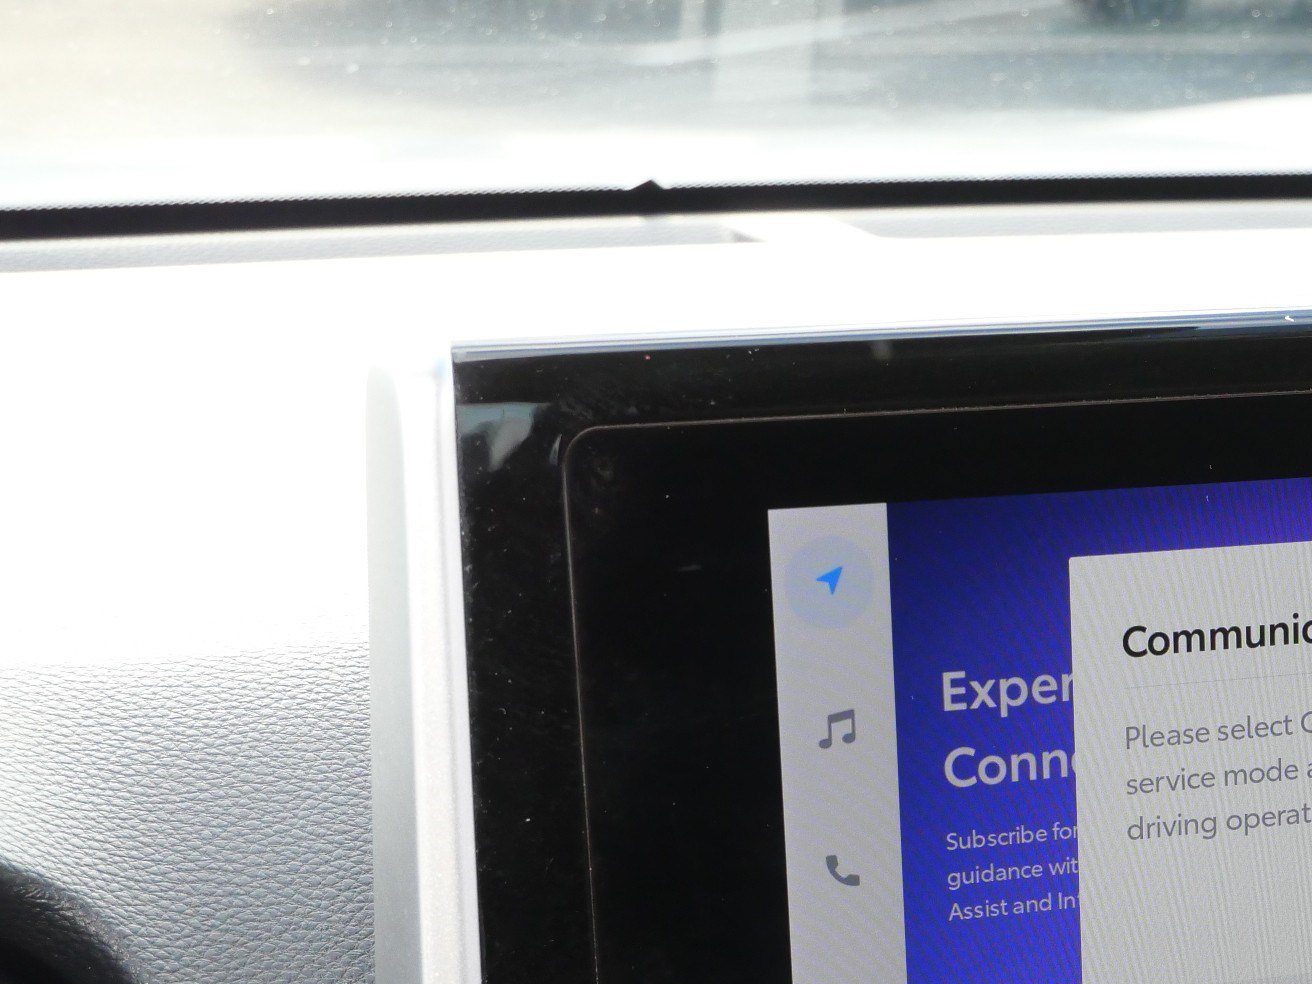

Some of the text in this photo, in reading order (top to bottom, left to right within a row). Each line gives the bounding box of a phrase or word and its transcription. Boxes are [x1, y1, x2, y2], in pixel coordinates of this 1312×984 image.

[1125, 724, 1211, 750] Please
[1217, 715, 1294, 742] select
[944, 746, 1076, 788] Conn
[1126, 767, 1216, 795] service
[1224, 757, 1299, 787] mode
[946, 821, 1078, 851] Subscribe for
[1127, 813, 1218, 840] driving
[947, 862, 1044, 891] guidance
[948, 899, 1009, 922] Assist
[1013, 892, 1052, 915] and
